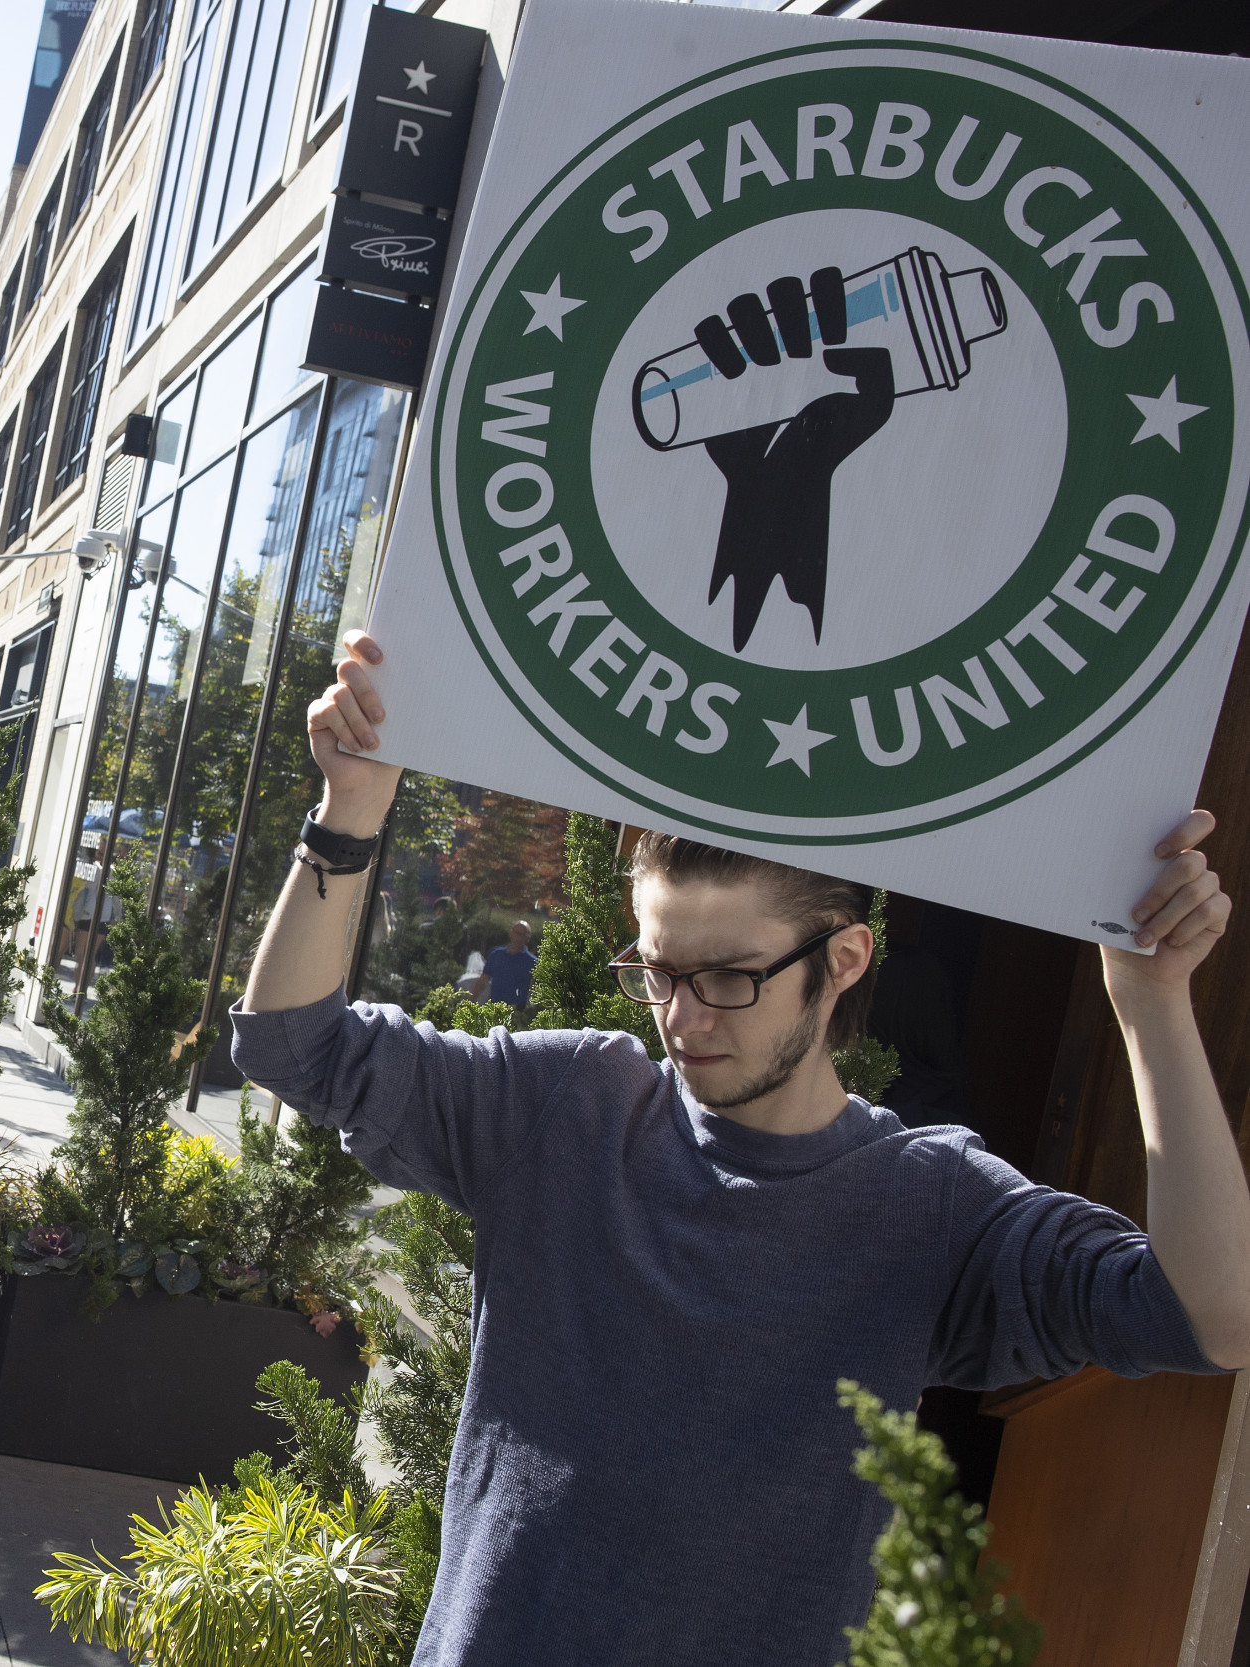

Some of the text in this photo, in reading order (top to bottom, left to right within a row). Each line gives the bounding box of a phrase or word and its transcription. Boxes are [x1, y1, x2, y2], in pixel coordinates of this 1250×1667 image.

[56, 1, 94, 11] HERM
[394, 118, 424, 157] R
[364, 221, 371, 229] di
[372, 224, 395, 235] Milano
[602, 102, 1175, 350] STARBUCKS
[350, 235, 437, 275] Princi
[481, 371, 742, 756] WORKERS
[849, 493, 1178, 768] UNITED
